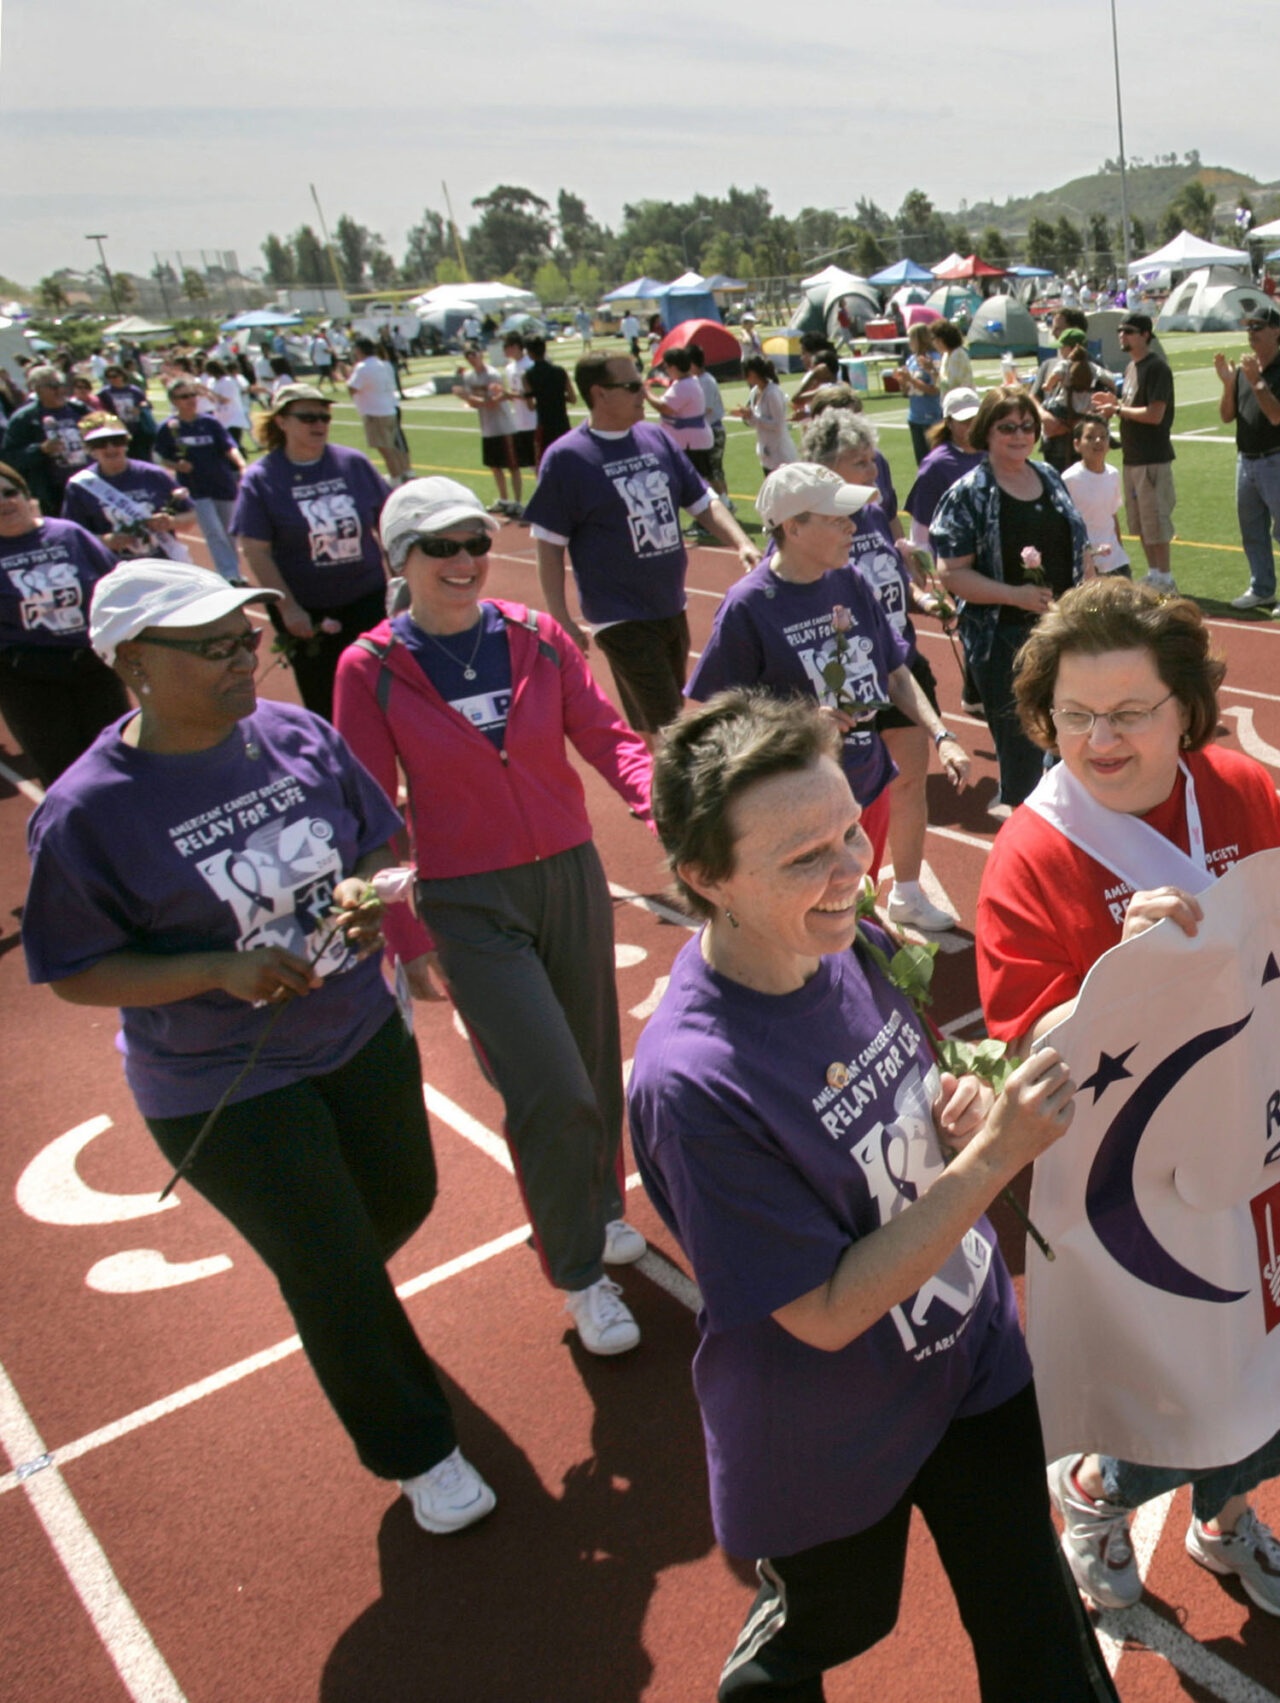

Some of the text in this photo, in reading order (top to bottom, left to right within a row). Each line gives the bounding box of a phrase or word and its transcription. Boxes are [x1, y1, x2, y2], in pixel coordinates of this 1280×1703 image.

[174, 816, 234, 858] RELAY
[237, 802, 271, 829] FOR
[812, 1059, 862, 1113] AMEAN
[821, 1074, 878, 1140] RELAY
[874, 1044, 905, 1088] FOR
